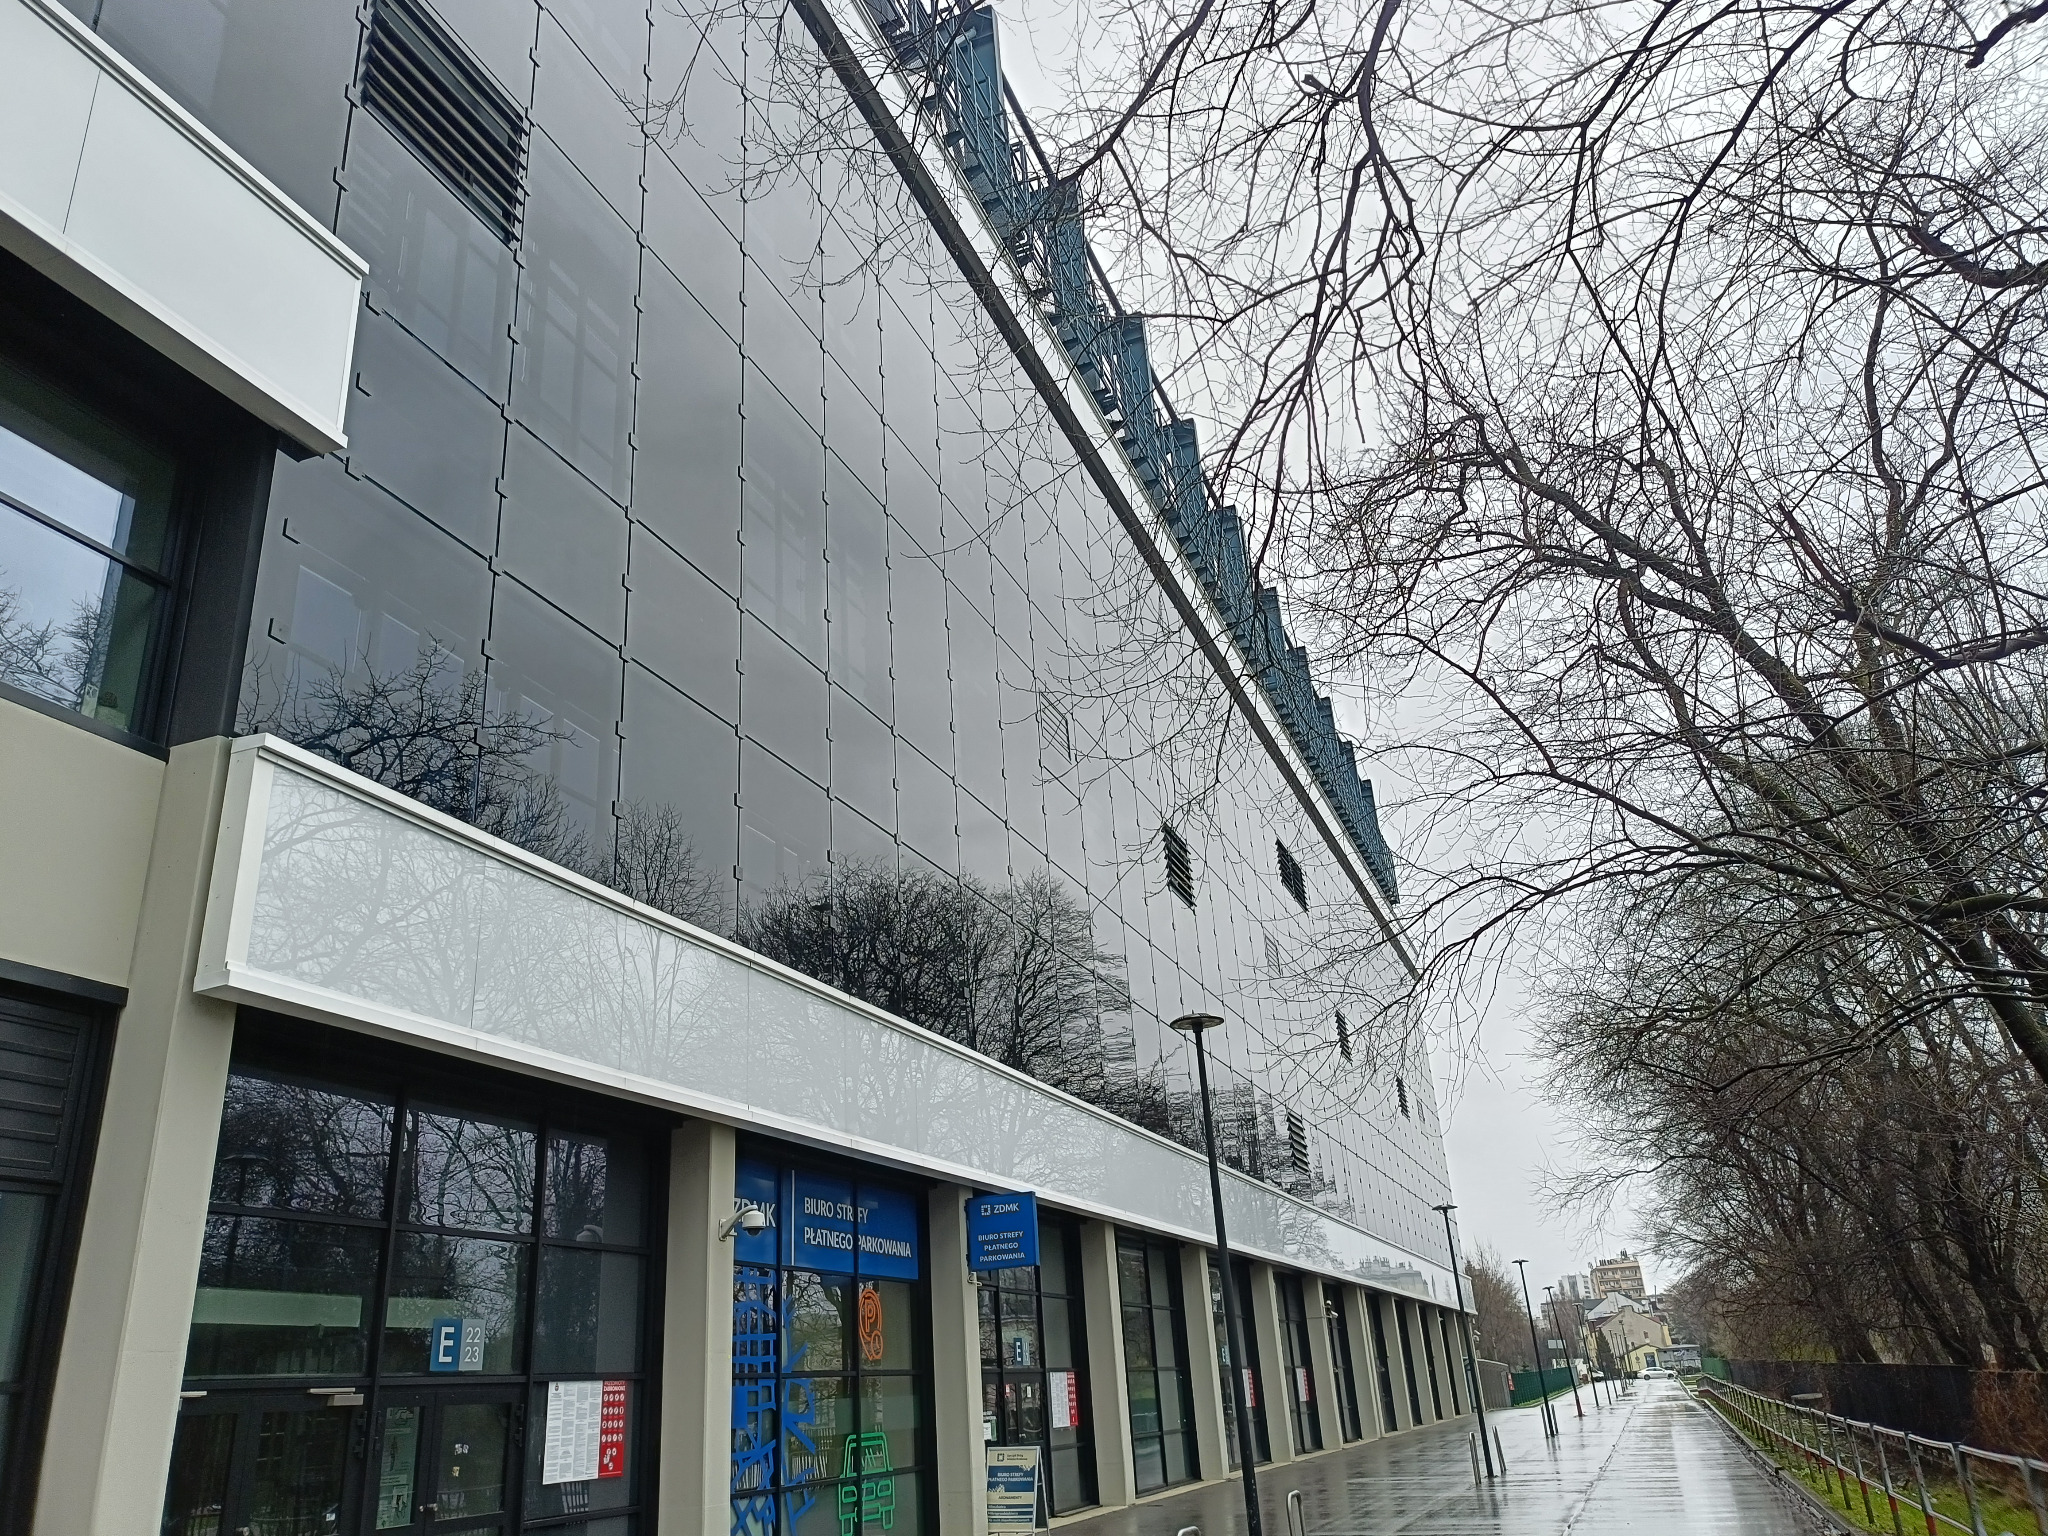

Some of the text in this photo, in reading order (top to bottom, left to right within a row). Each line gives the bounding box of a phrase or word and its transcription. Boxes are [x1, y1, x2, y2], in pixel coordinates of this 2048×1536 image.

[804, 1197, 869, 1224] BIURO STRFY
[993, 1203, 1019, 1214] ZDMK
[804, 1227, 854, 1250] PŁATNEGO
[999, 1231, 1024, 1240] STREFY
[984, 1242, 1019, 1251] PŁATNEGO
[979, 1252, 1026, 1262] PARKOWANIA
[438, 1326, 481, 1363] E 22
[1015, 1341, 1022, 1362] E
[464, 1346, 479, 1362] 23
